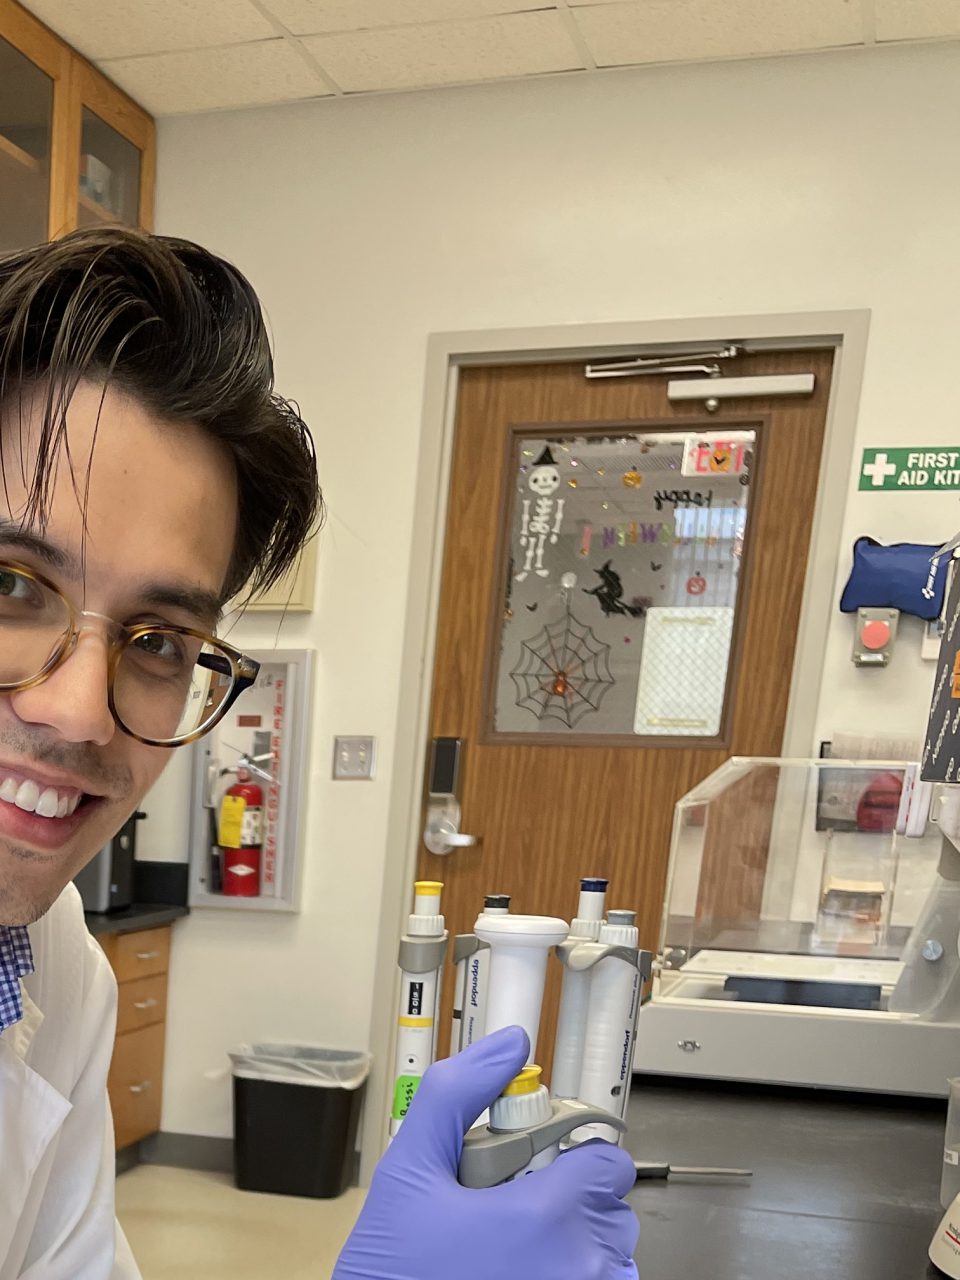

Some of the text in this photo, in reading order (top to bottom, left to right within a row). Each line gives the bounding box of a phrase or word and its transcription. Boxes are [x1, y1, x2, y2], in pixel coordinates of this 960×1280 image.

[897, 469, 960, 486] AID KIT
[907, 452, 960, 469] FIRST
[272, 679, 285, 730] FIRE
[470, 958, 480, 1008] eppendorf
[619, 1029, 631, 1081] eppendorf
